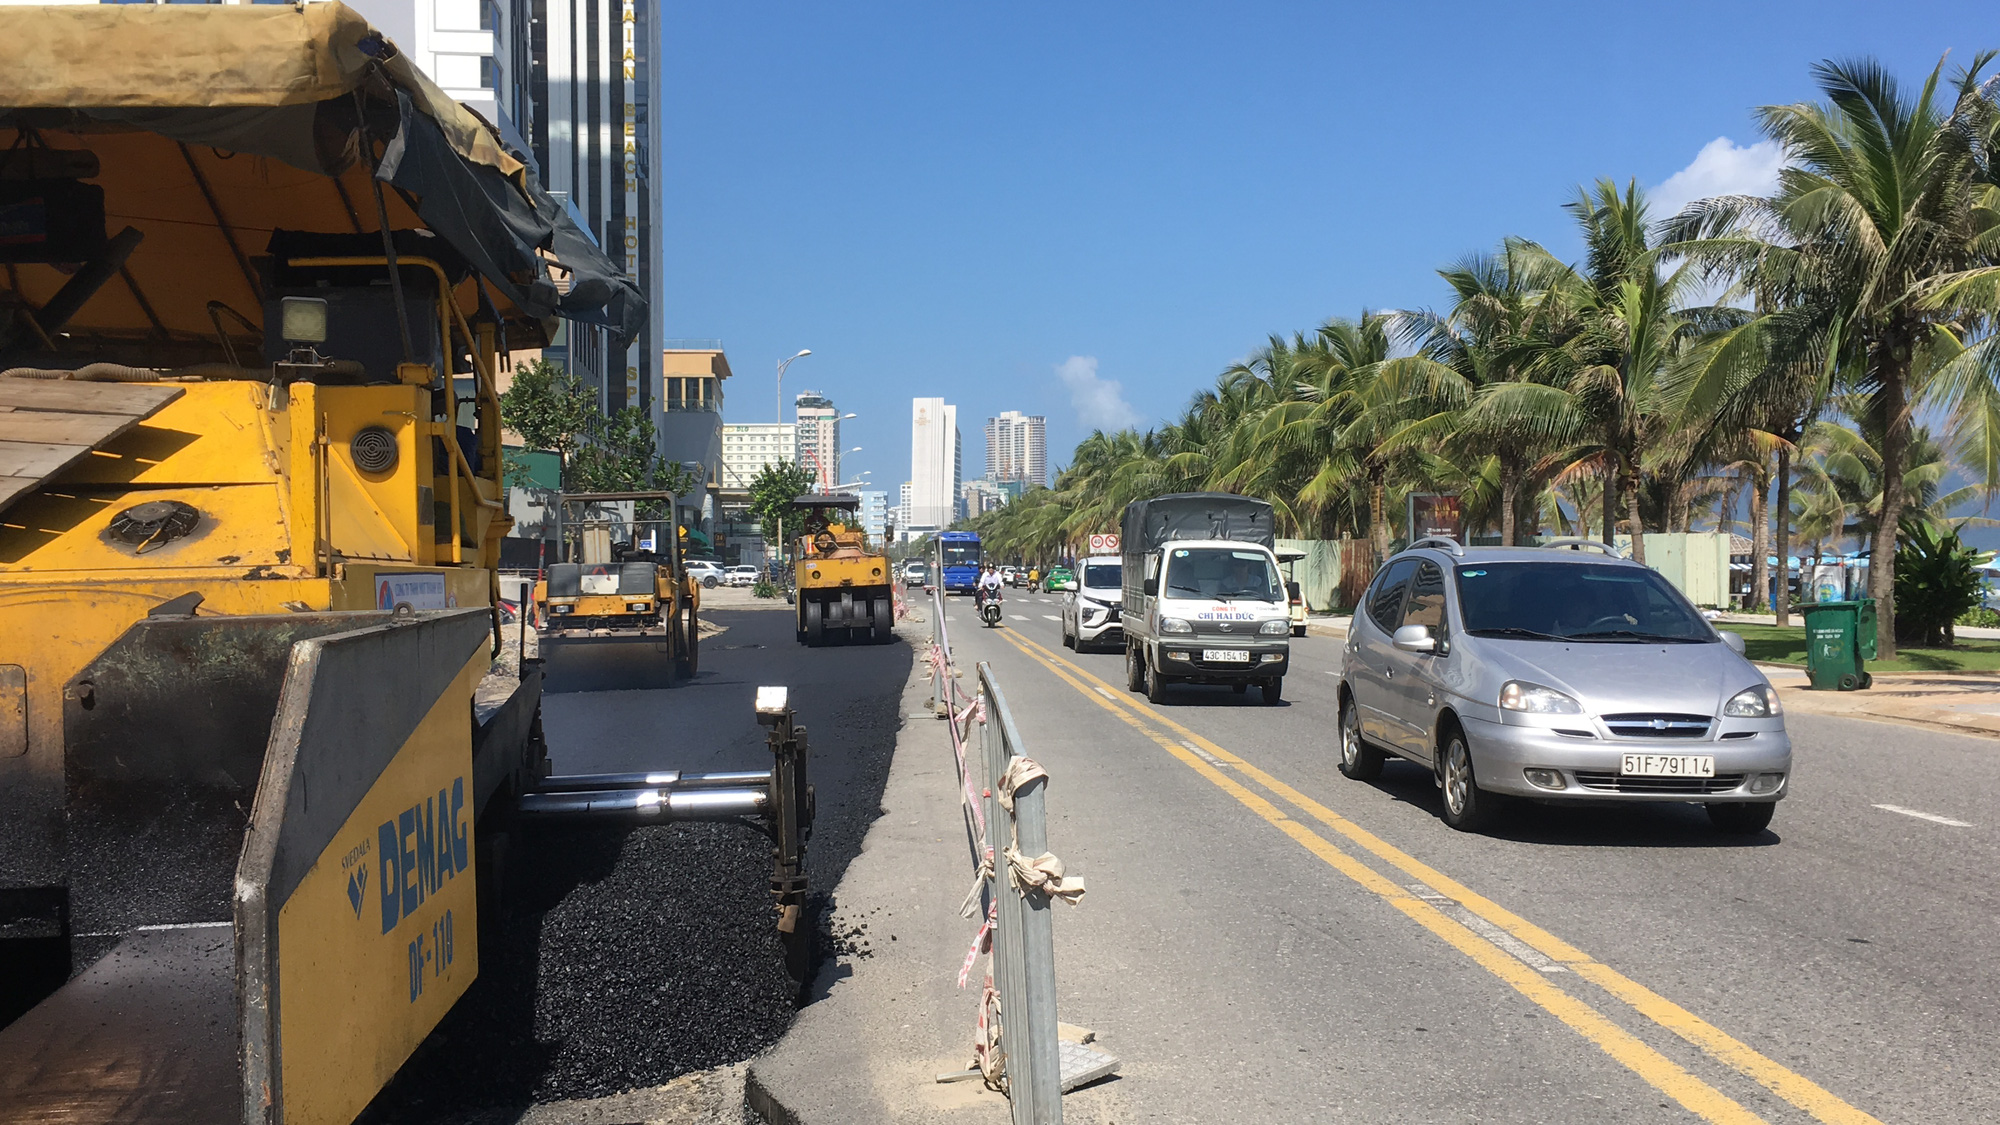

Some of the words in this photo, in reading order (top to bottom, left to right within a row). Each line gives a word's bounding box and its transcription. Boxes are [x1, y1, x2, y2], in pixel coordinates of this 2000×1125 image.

[622, 0, 636, 81] AIAN
[624, 103, 636, 193] BEACH
[626, 366, 638, 401] SP
[1235, 611, 1255, 621] ĐỨC
[378, 776, 468, 936] DEMAG
